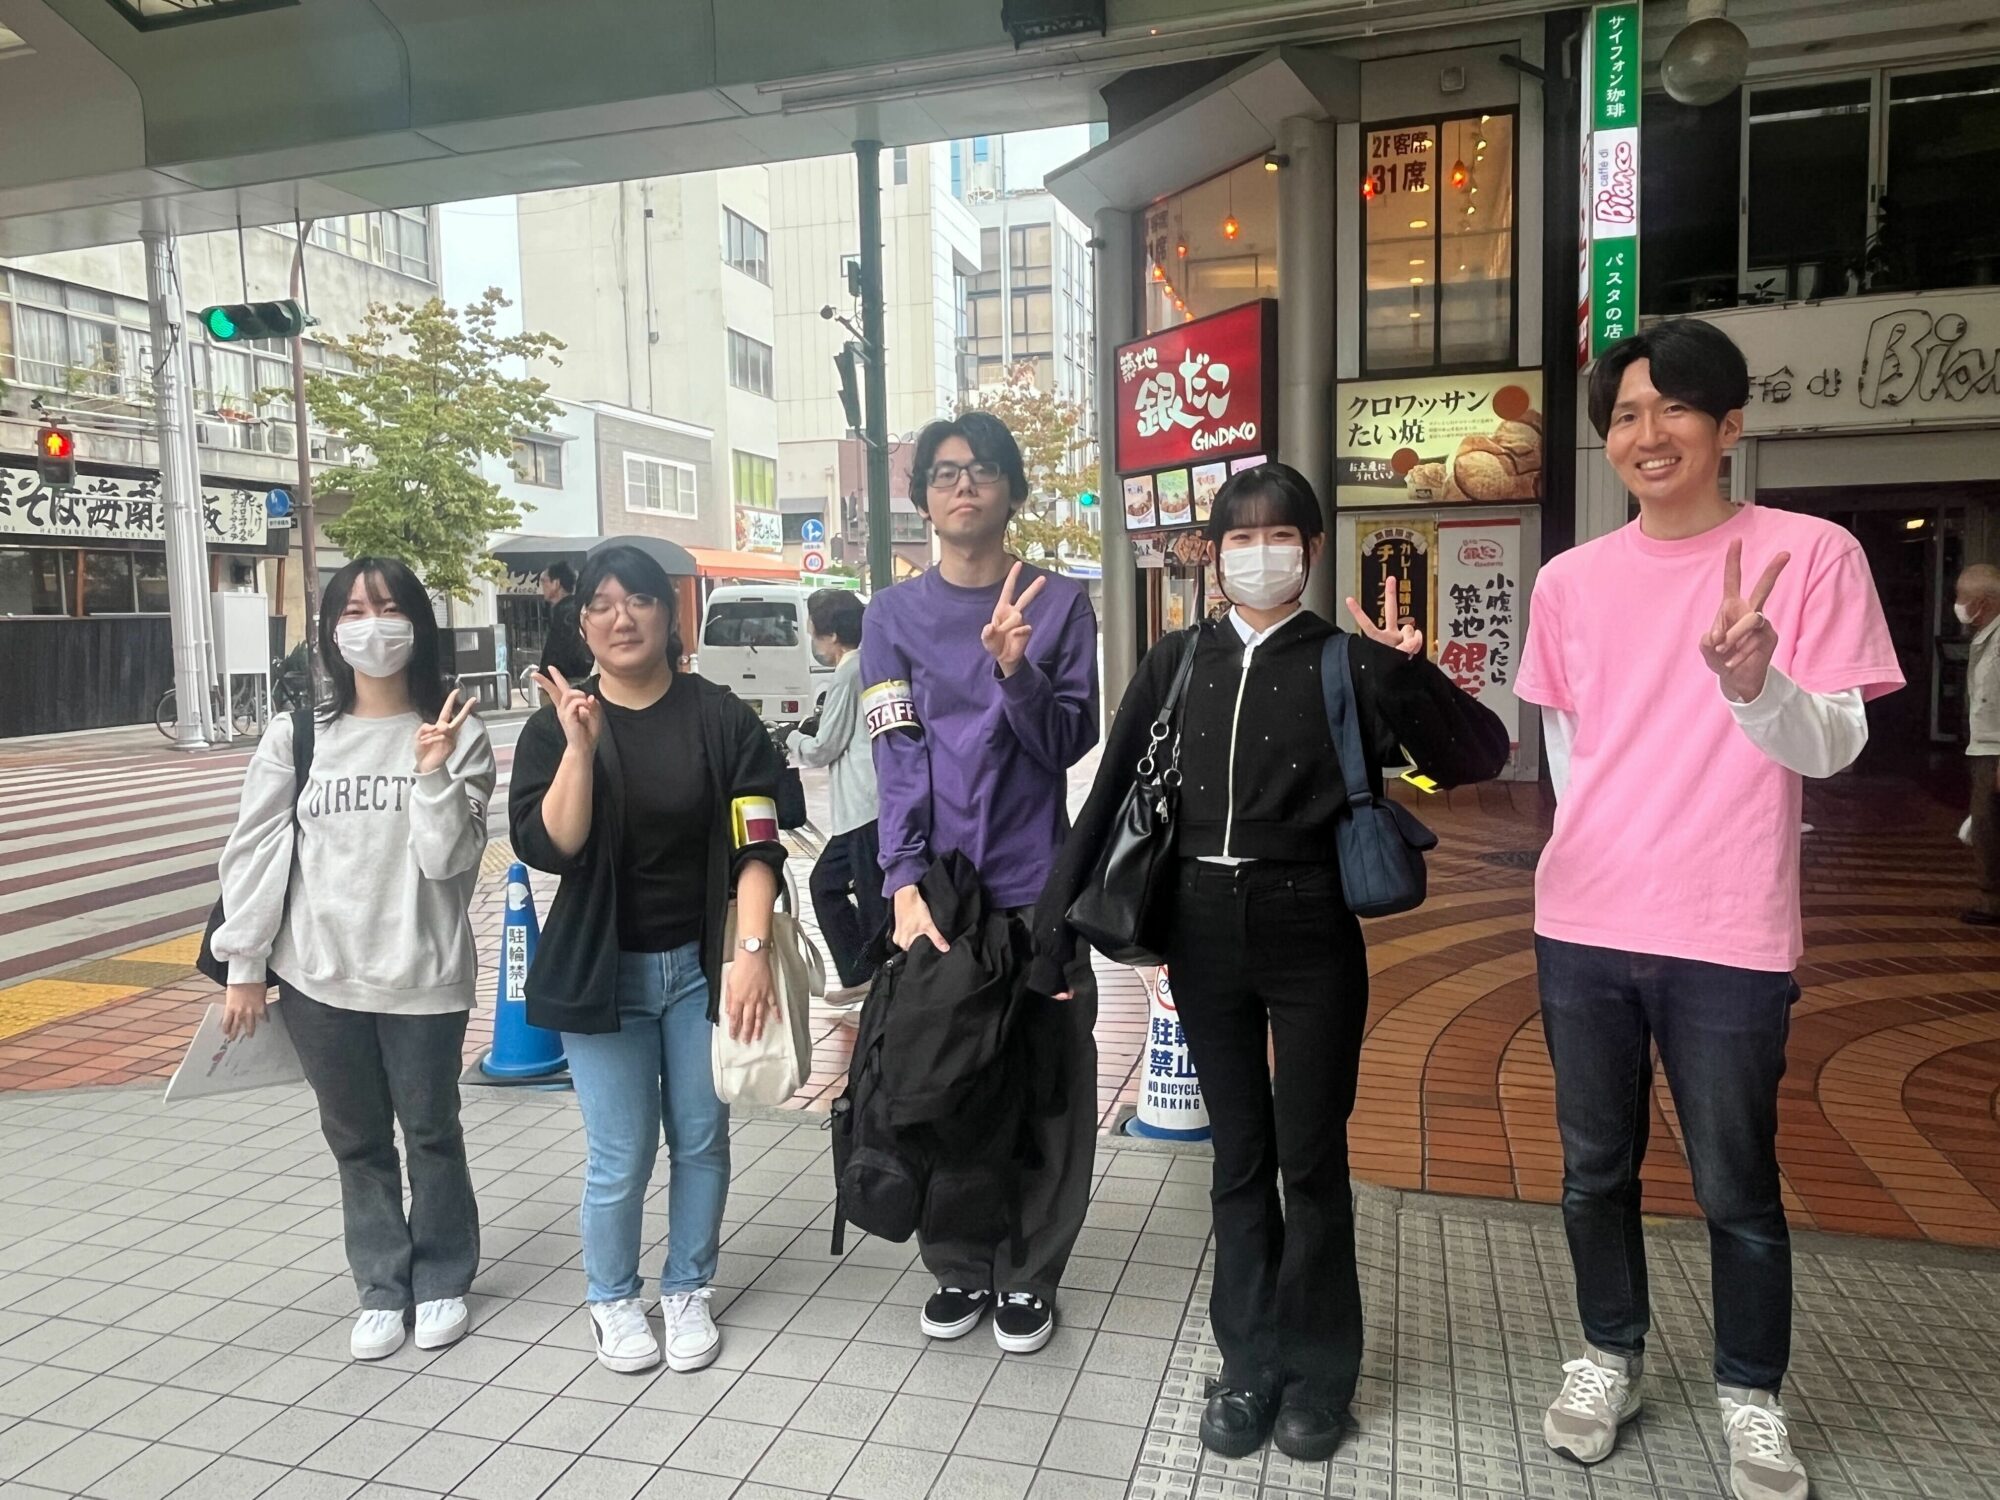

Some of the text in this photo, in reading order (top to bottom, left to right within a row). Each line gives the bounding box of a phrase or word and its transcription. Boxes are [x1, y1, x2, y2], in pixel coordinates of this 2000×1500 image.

[1606, 15, 1626, 118] サイフォン珈琲
[1595, 141, 1636, 224] Bianco
[1603, 252, 1624, 339] パスタの店
[1119, 347, 1158, 384] 築地
[1135, 347, 1231, 437] 銀だこ
[1347, 391, 1490, 420] クロワッサン
[1191, 421, 1256, 451] GINDACO
[1348, 418, 1425, 448] たい焼
[808, 557, 820, 568] 40
[1485, 573, 1515, 686] 小腹がへったら
[867, 702, 915, 733] STAFF
[508, 928, 525, 999] 駐輪禁止
[1149, 1049, 1198, 1078] 禁止
[1147, 1094, 1200, 1110] PARKING
[1148, 1080, 1200, 1096] NO BICYCLE
